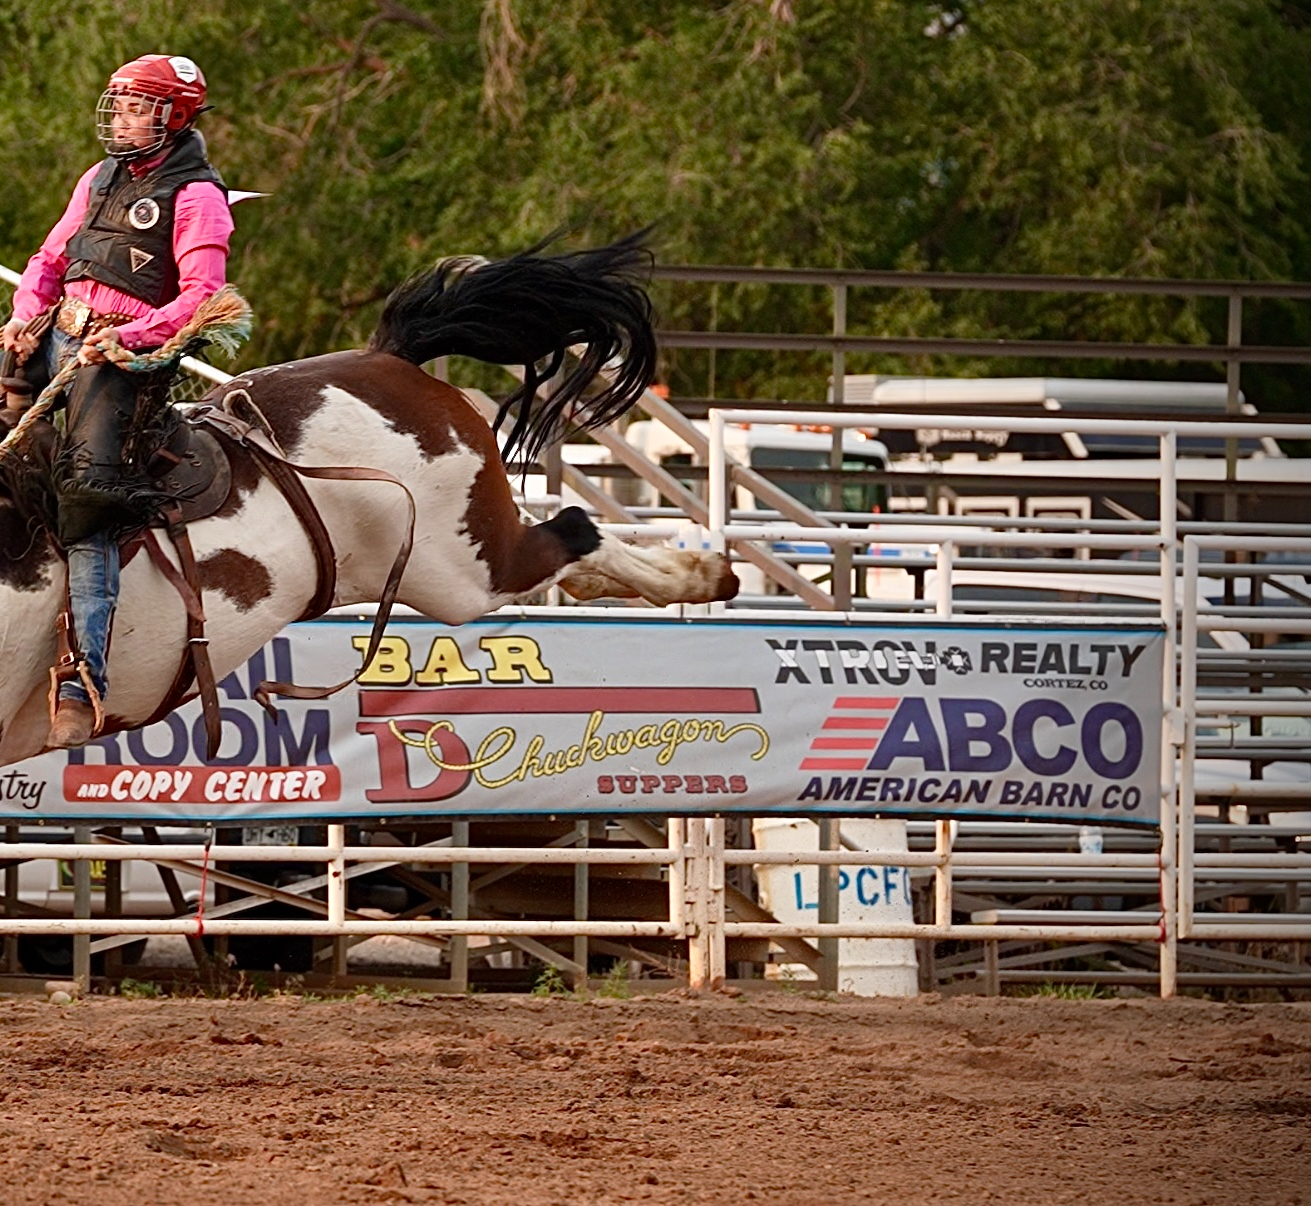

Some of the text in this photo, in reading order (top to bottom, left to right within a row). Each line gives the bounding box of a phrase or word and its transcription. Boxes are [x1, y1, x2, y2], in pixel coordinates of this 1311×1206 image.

[352, 635, 553, 686] BAR
[980, 642, 1147, 678] REALTY
[1023, 678, 1108, 691] CORTEZ, CO
[390, 710, 770, 788] Chuckwagon
[866, 696, 1144, 779] ABCO
[77, 769, 326, 801] AND COPY CENTER
[597, 774, 748, 794] SUPPERS
[797, 776, 1142, 811] AMERICAN BARN CO
